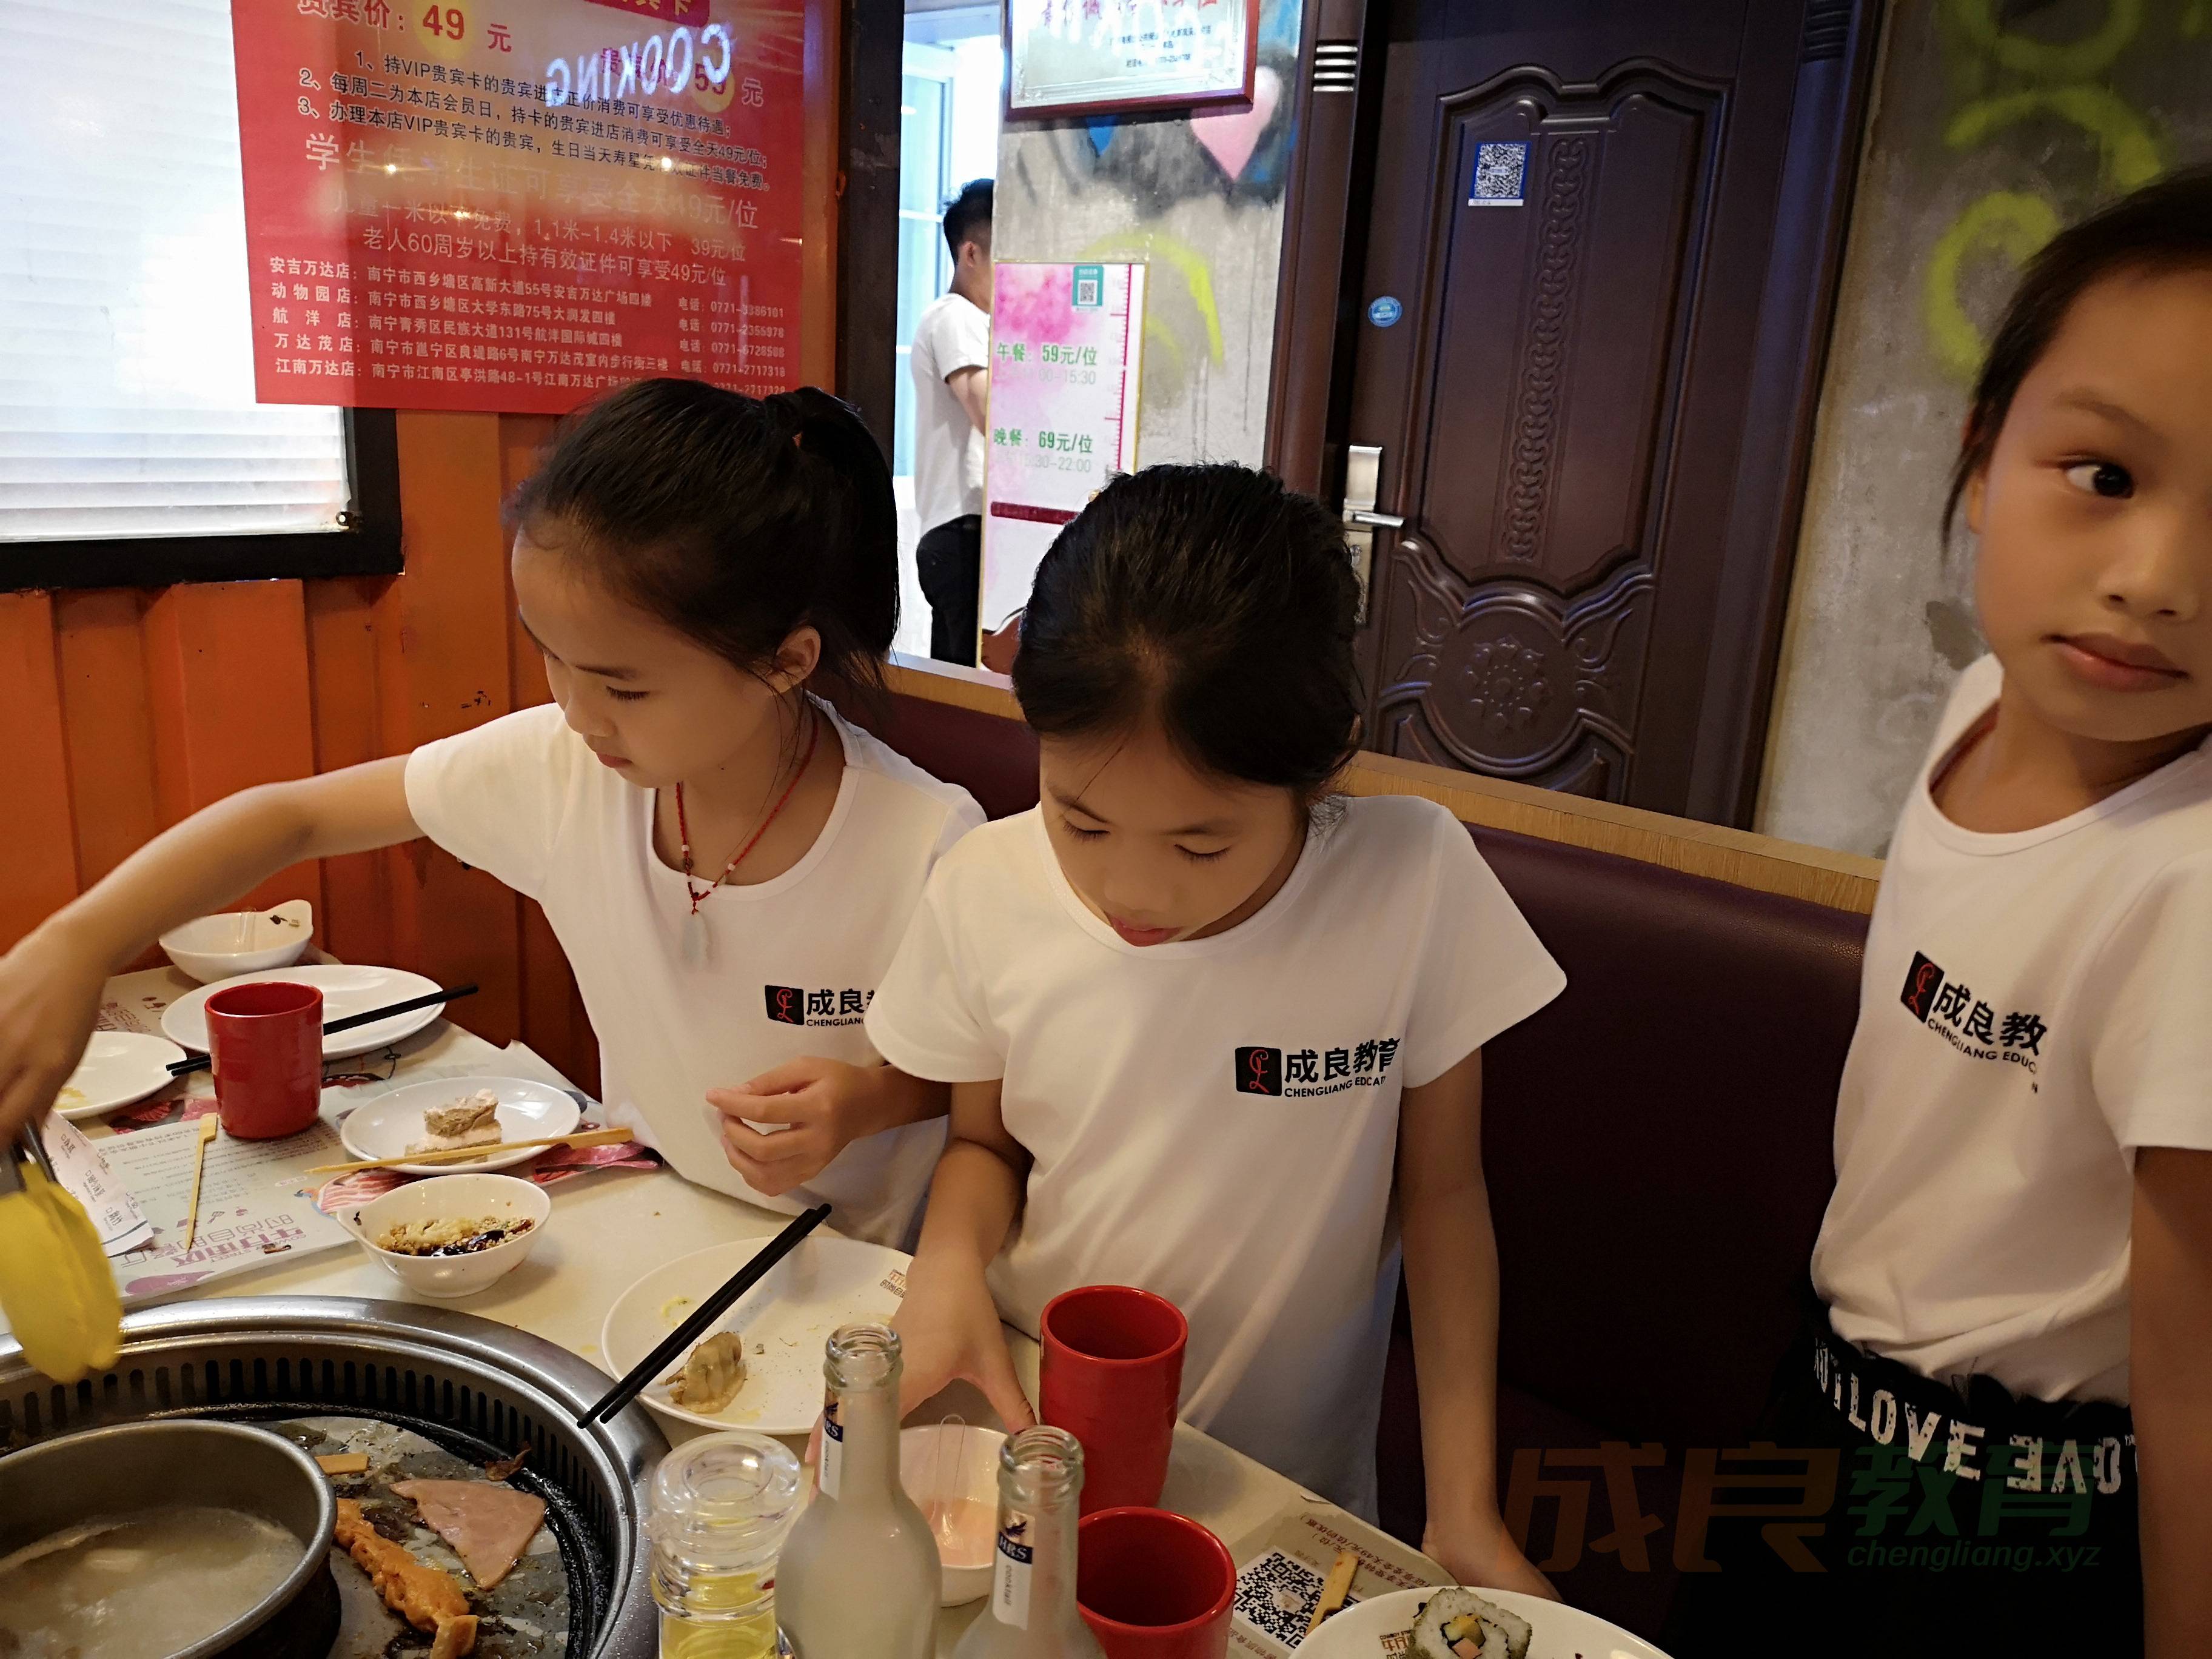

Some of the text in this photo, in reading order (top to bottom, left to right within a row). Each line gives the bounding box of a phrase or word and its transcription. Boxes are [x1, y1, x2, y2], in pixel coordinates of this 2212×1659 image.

[422, 5, 465, 41] 49
[486, 23, 512, 53] 元
[742, 77, 765, 107] 元
[1042, 344, 1097, 366] 59元/位
[1039, 431, 1093, 453] 69元/位
[1284, 1037, 1401, 1084] 成良教育
[1284, 1079, 1353, 1098] CHENGLIANG
